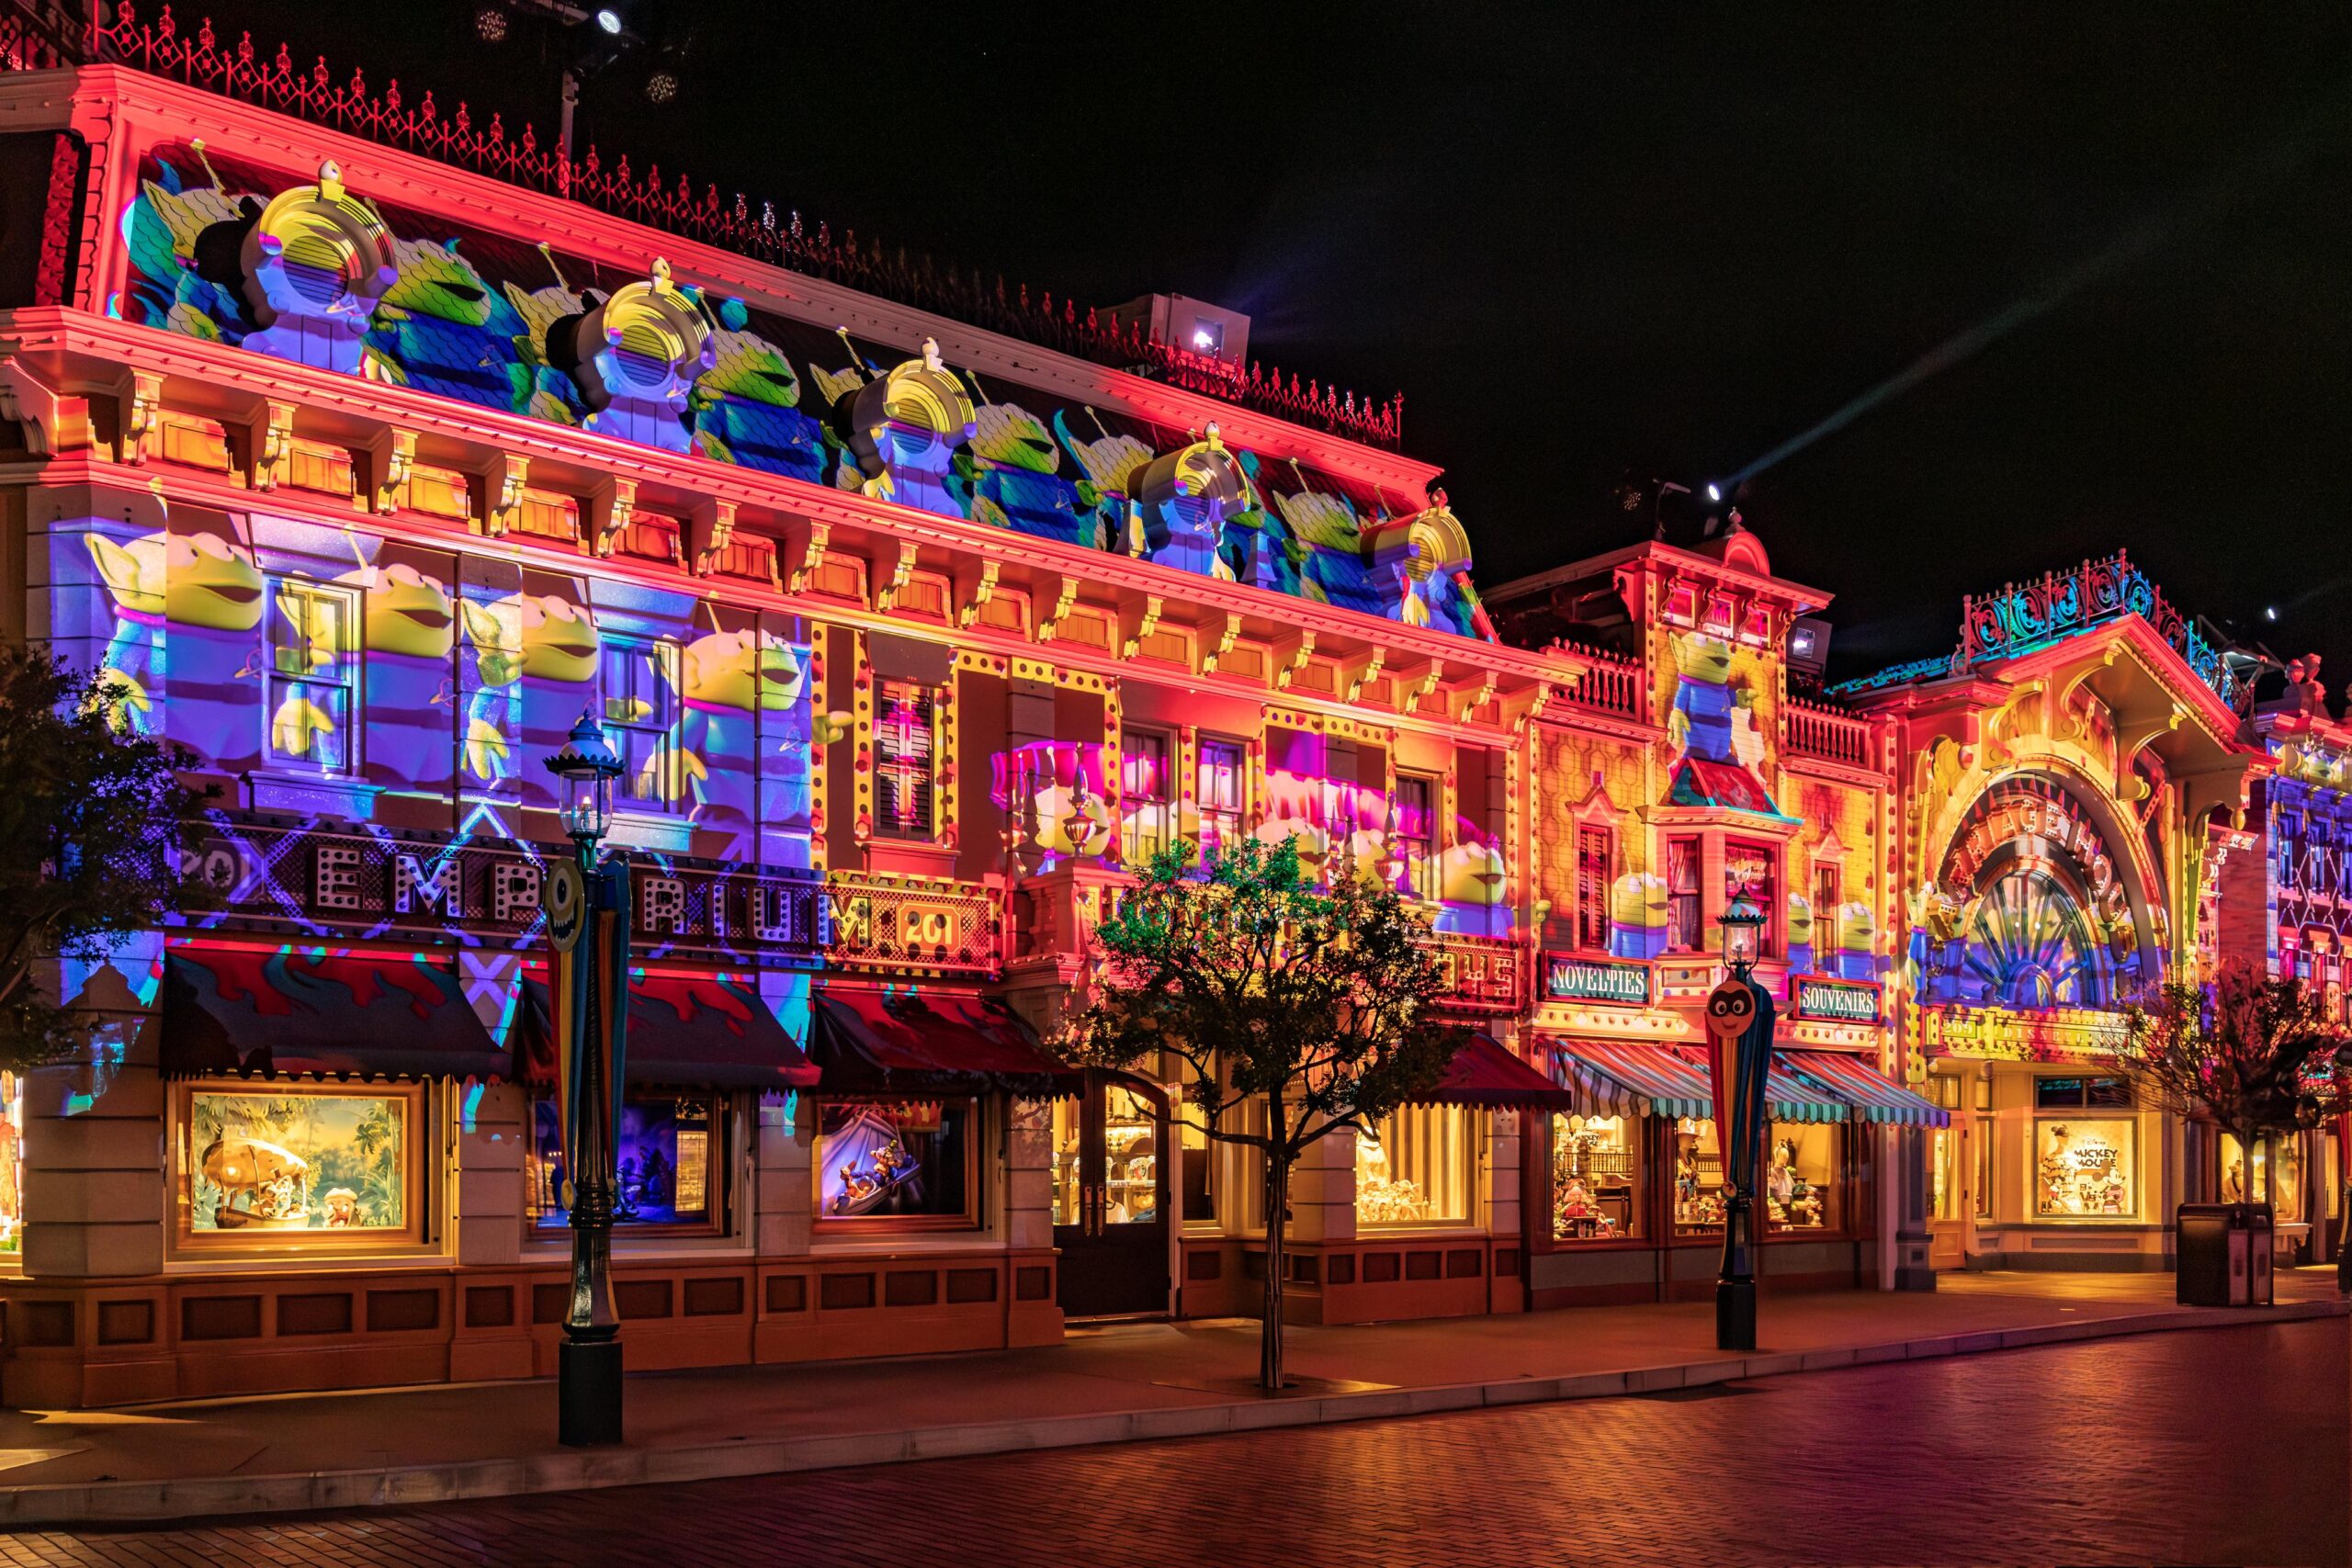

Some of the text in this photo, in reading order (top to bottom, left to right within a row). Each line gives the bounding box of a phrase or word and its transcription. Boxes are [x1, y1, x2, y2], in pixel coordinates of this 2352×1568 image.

[317, 846, 873, 948] EMPRIUM
[905, 912, 953, 945] 201
[1552, 964, 1645, 995] NOVELTIES
[1803, 986, 1874, 1014] SOUVENIRS
[1941, 1019, 1973, 1034] 209
[2074, 1148, 2119, 1158] MICKEY
[2076, 1157, 2117, 1168] MOUE
